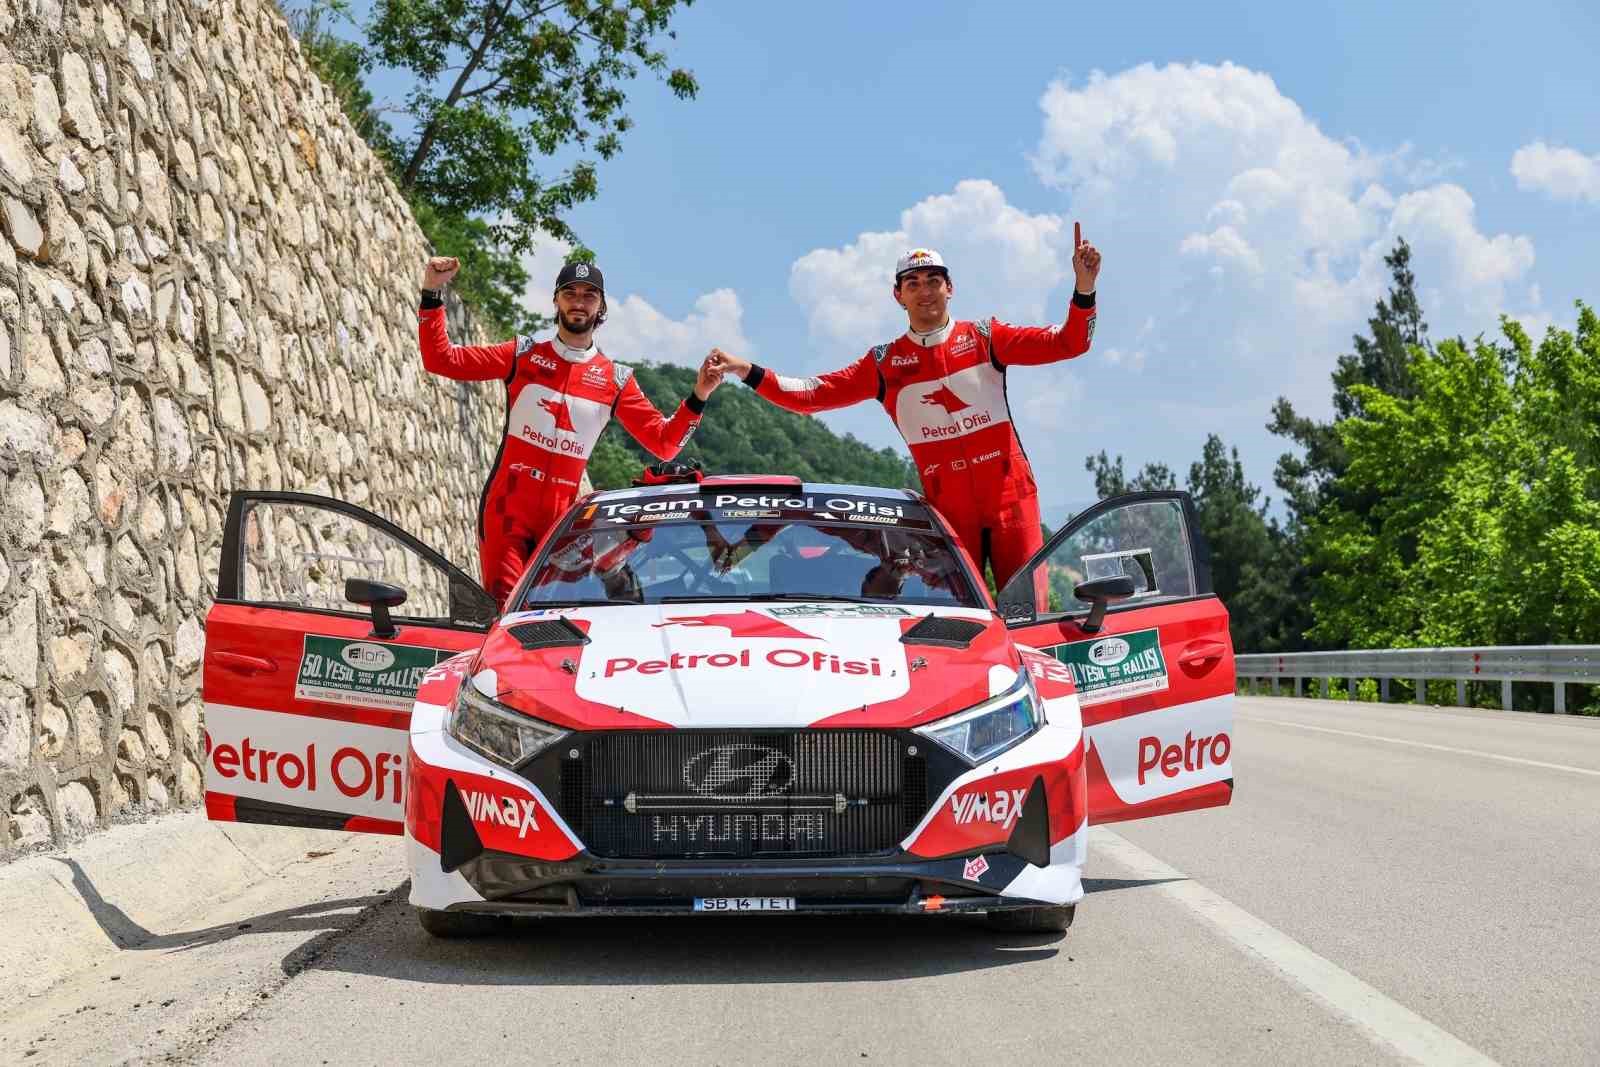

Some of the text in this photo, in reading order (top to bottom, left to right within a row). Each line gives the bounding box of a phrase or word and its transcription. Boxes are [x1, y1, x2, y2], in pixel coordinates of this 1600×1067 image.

[921, 411, 991, 439] Petrol Ofisi
[522, 425, 585, 456] Petrol Ofisi
[601, 500, 704, 516] Team
[715, 495, 814, 508] Petrol
[825, 499, 904, 517] Ofisi
[302, 653, 323, 678] 50.
[604, 649, 881, 678] Petrol Ofisi
[1138, 728, 1231, 785] Petro
[654, 815, 823, 841] HYUNDAI
[703, 898, 728, 909] SB
[736, 898, 751, 909] 14
